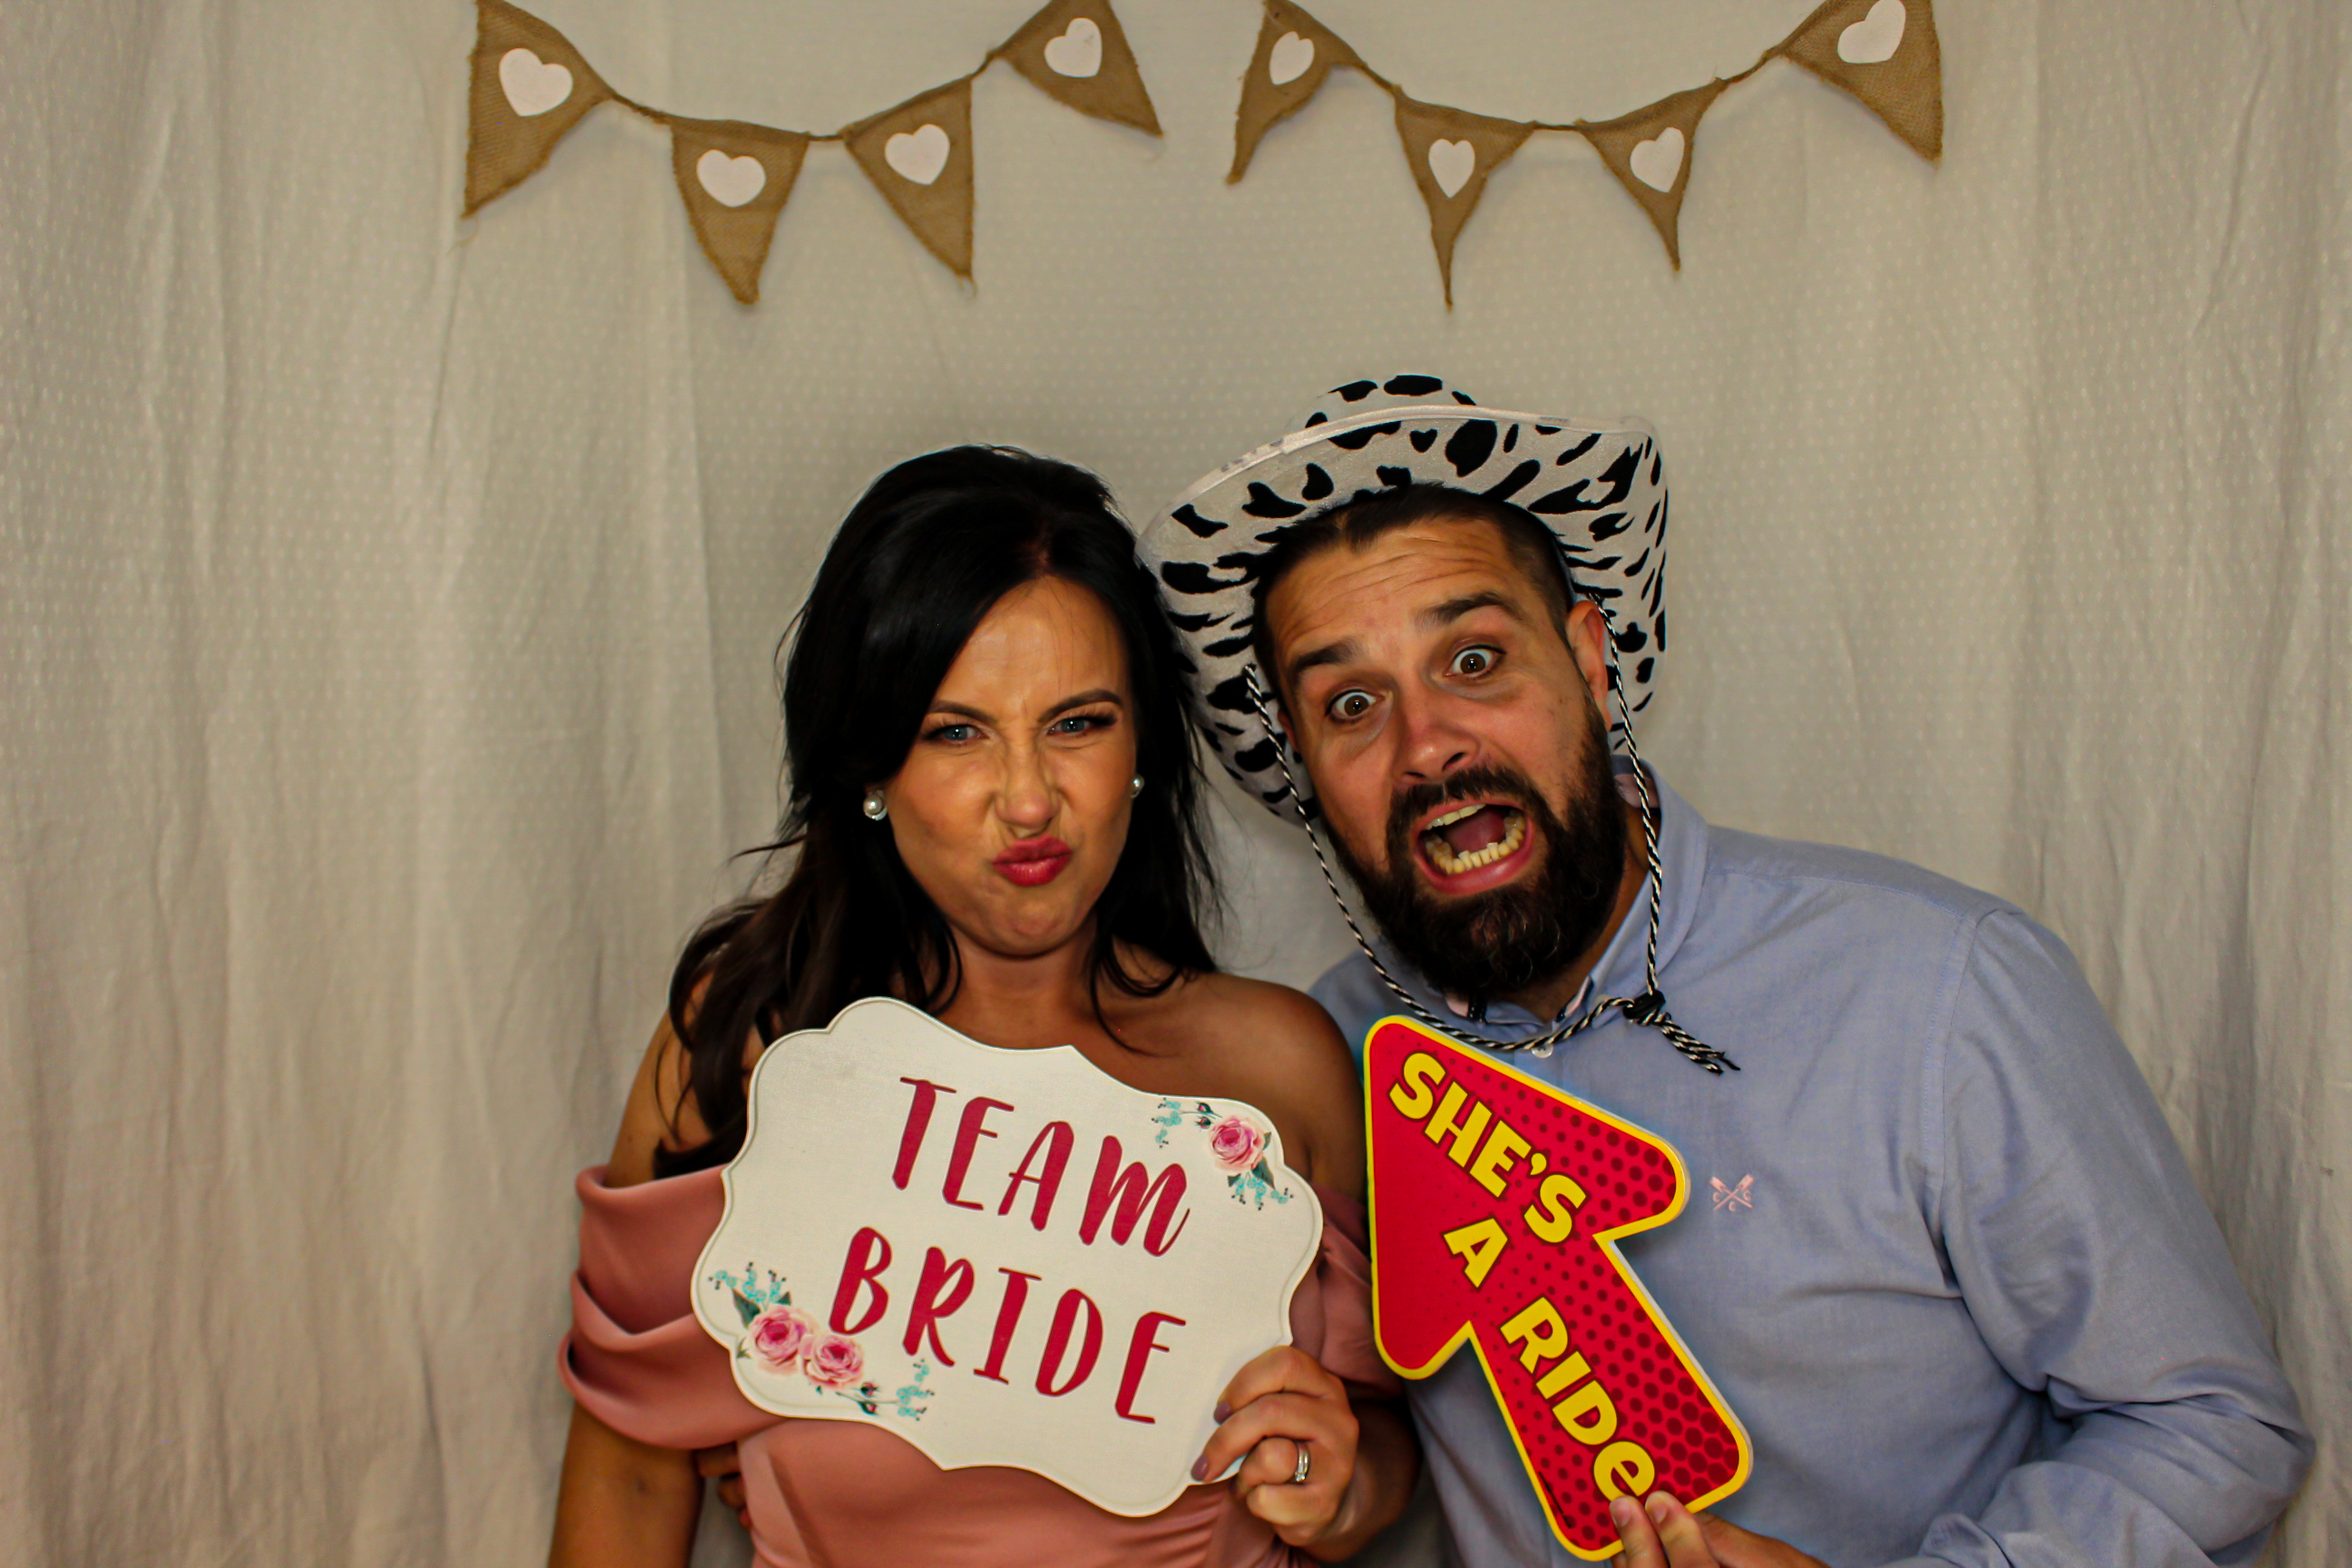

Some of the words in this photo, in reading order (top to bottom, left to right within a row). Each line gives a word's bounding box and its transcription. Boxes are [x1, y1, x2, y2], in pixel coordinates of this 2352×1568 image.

[891, 1076, 1191, 1256] TEAM
[1388, 1052, 1588, 1244] SHE'S
[828, 1226, 1187, 1424] BRIDE
[1441, 1217, 1509, 1289] A
